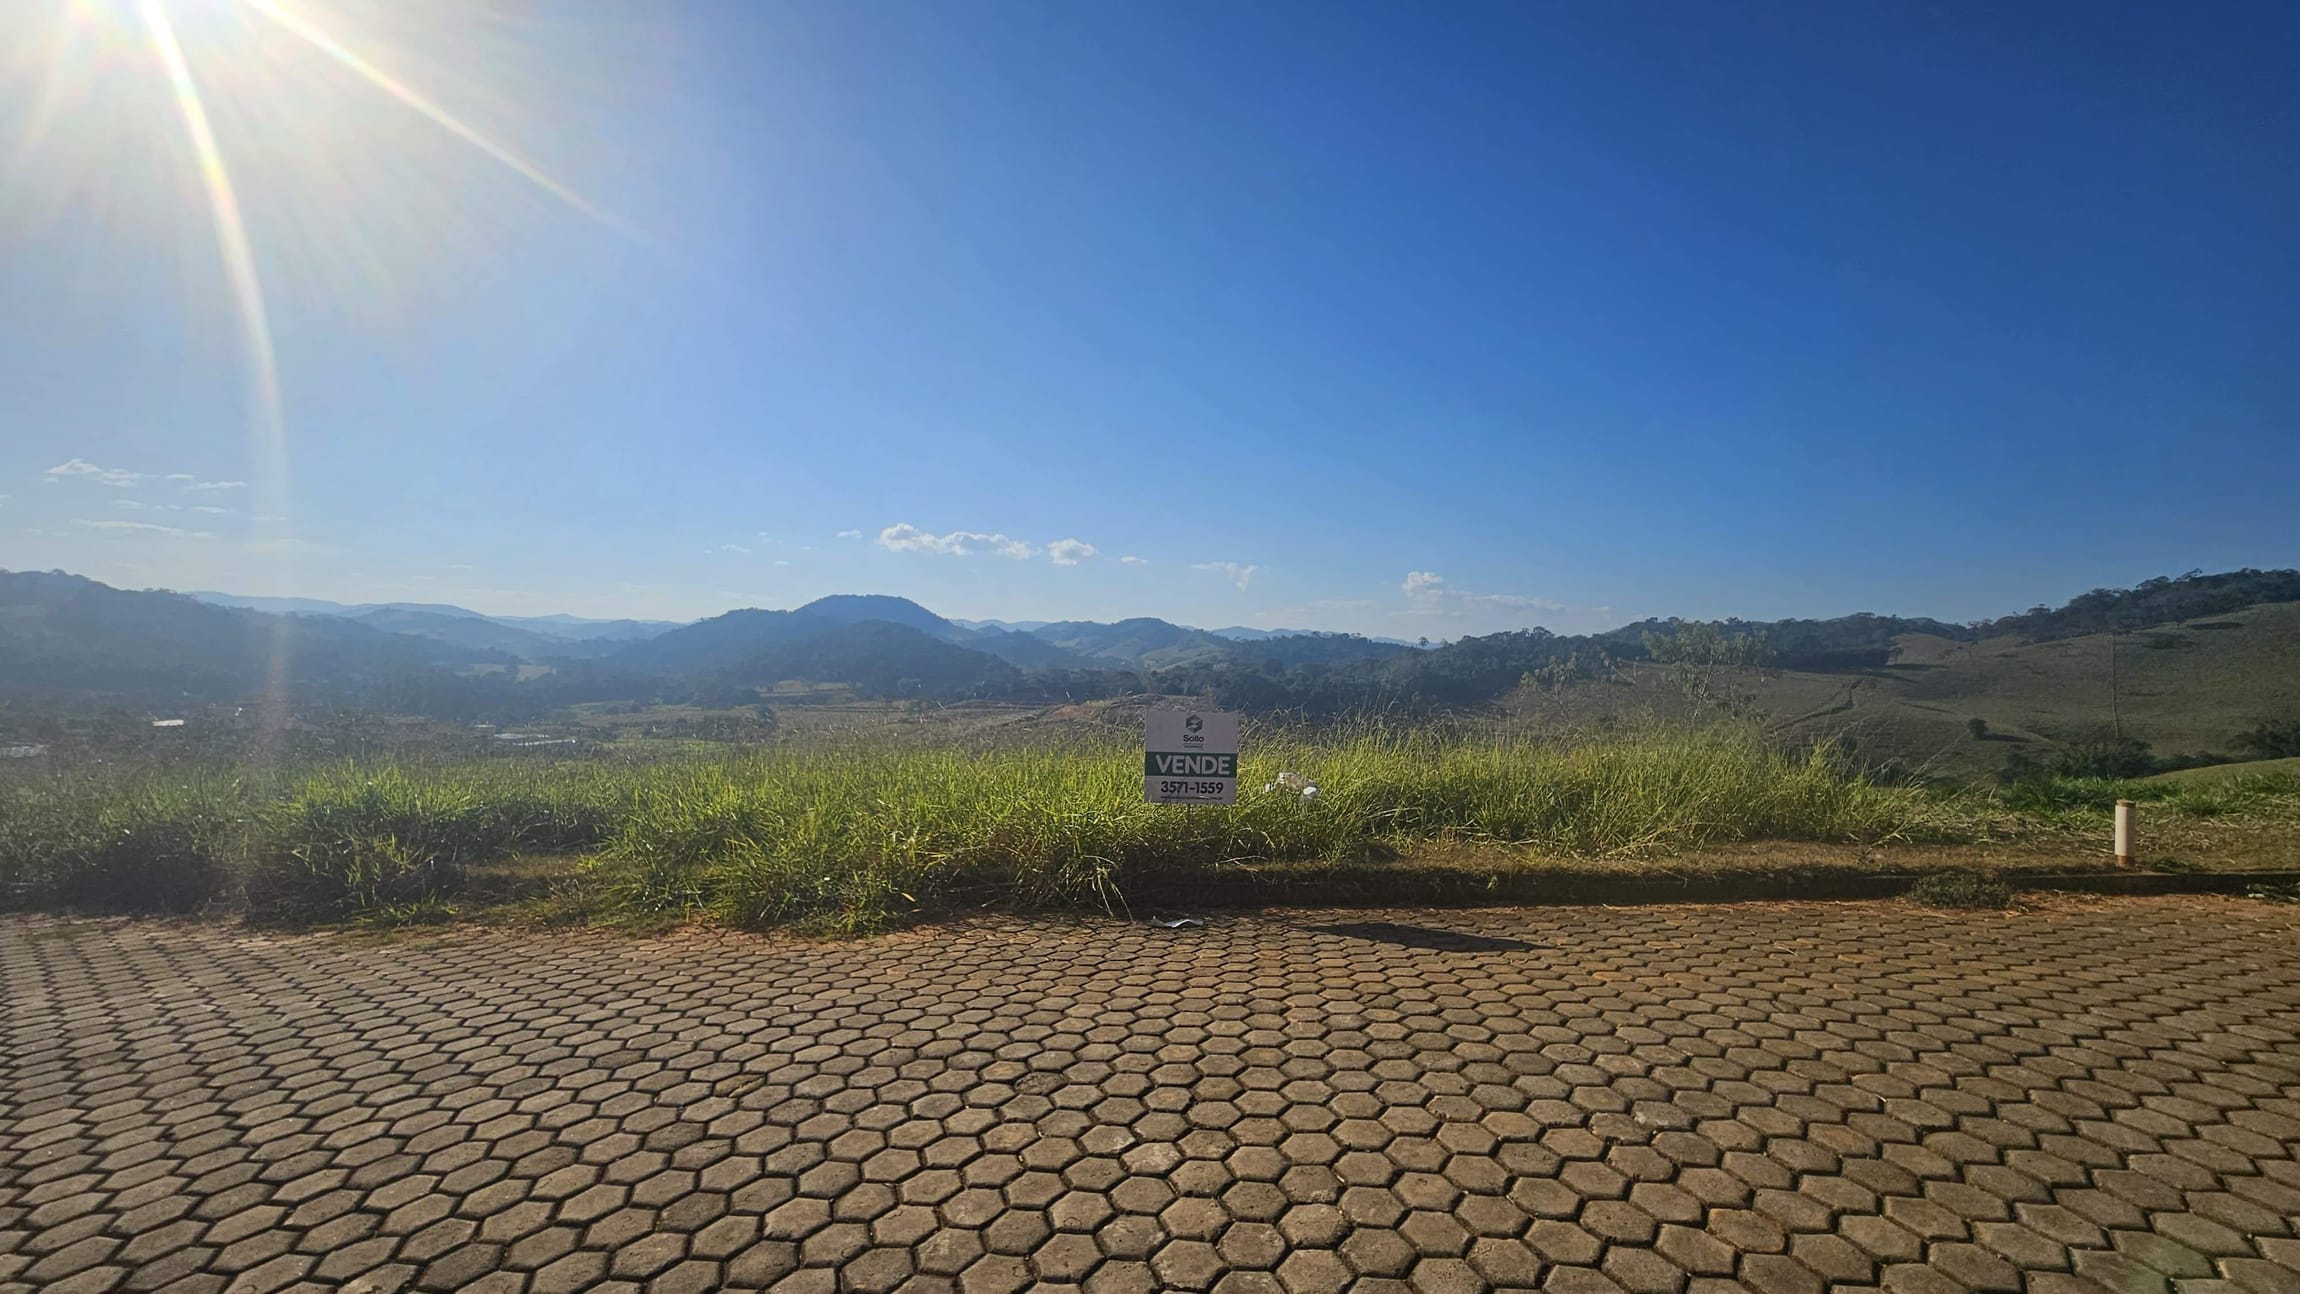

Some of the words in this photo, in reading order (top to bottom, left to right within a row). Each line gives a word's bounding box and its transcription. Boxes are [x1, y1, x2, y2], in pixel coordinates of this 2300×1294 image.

[1183, 734, 1204, 742] Sollo
[1155, 754, 1231, 774] VENDE
[1160, 781, 1224, 794] 3571-1559
